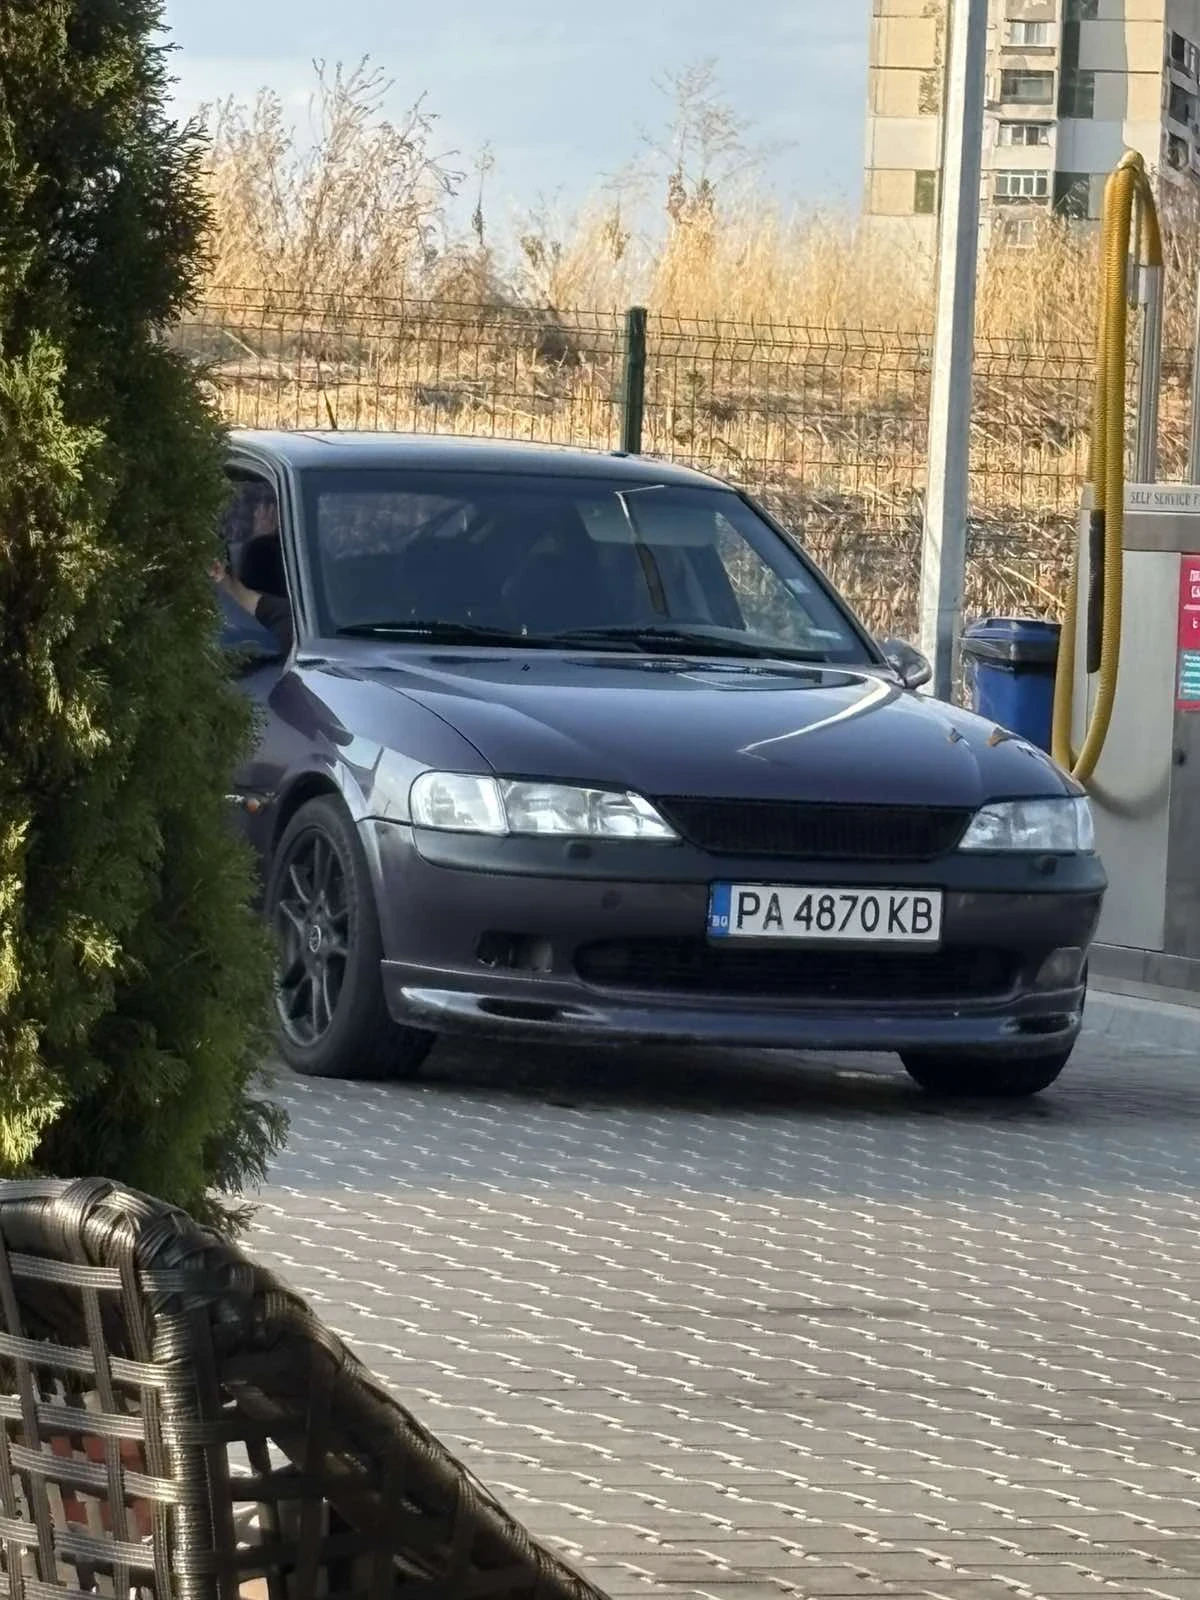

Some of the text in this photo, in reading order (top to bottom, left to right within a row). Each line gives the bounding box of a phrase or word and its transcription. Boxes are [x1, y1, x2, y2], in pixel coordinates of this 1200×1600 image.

[1130, 491, 1151, 505] SELF
[1154, 492, 1191, 506] SERVICE
[737, 891, 932, 934] PA 4870 KB
